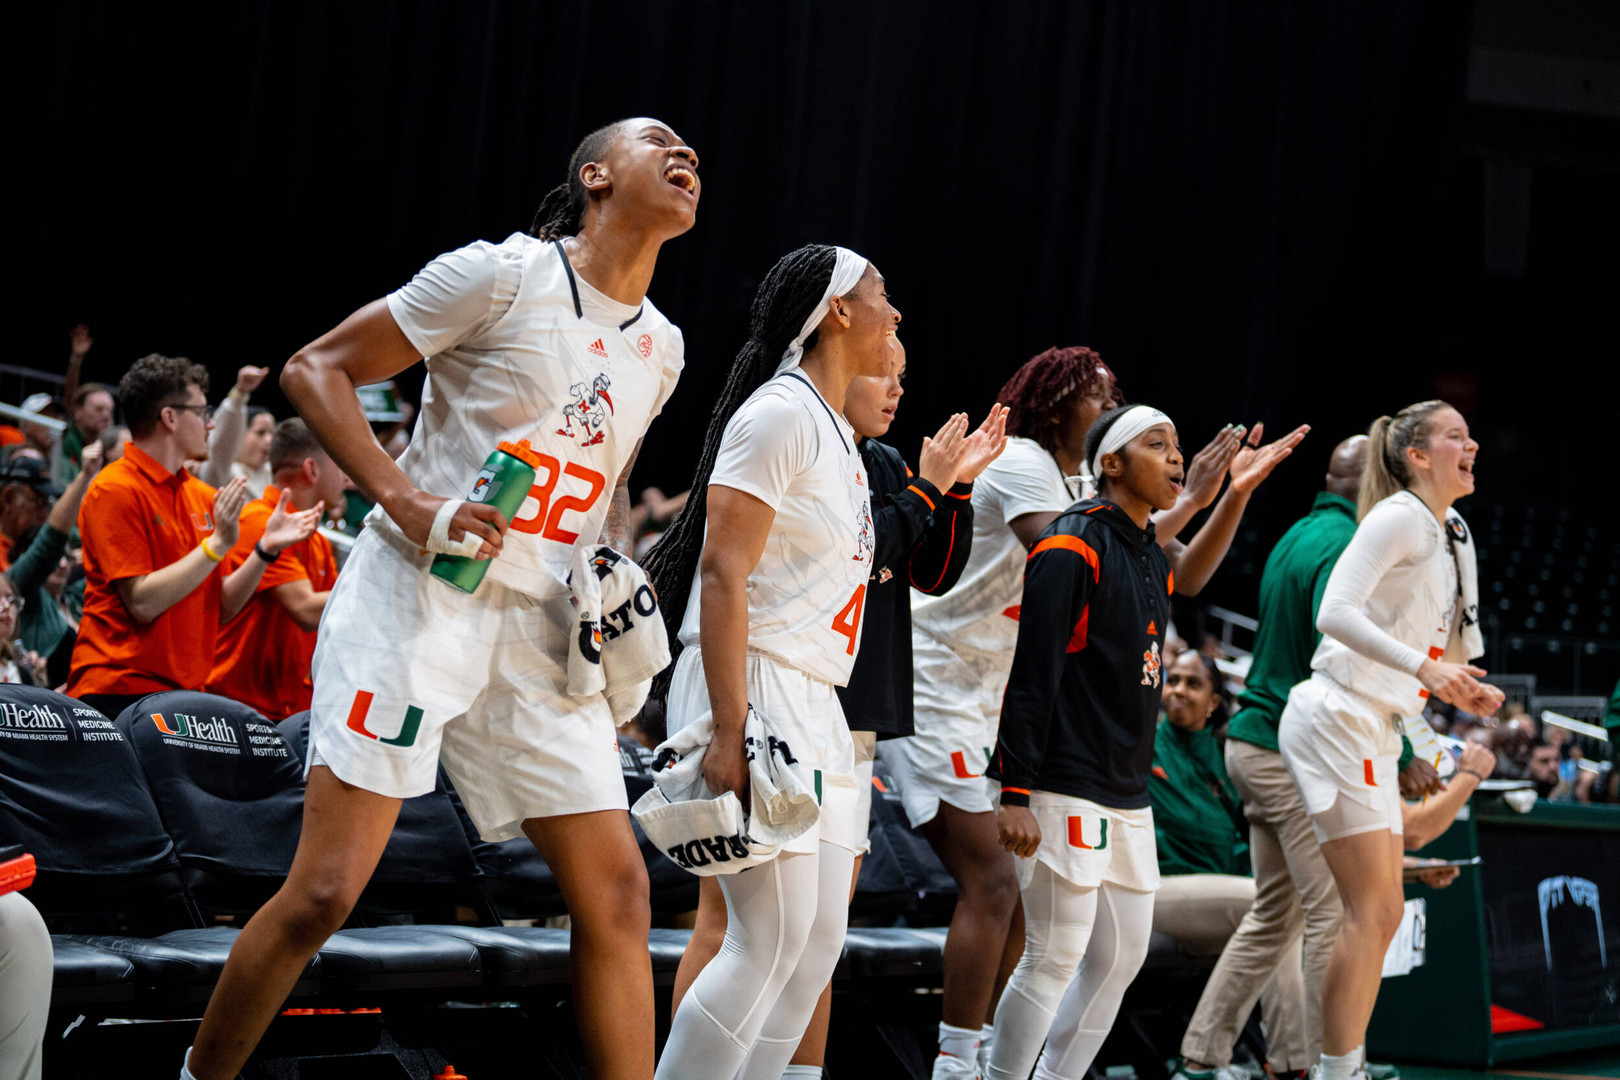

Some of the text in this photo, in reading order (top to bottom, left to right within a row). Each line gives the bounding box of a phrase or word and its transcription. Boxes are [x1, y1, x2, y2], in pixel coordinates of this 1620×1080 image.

[831, 583, 866, 656] 4
[72, 707, 102, 718] SPORTS
[345, 688, 425, 748] U
[77, 720, 116, 730] MEDICINE
[245, 723, 273, 734] SPORTS
[82, 732, 124, 742] INSTITUTE
[249, 735, 283, 746] MEDICINE
[252, 747, 289, 758] INSTITUTE
[1067, 815, 1109, 851] U
